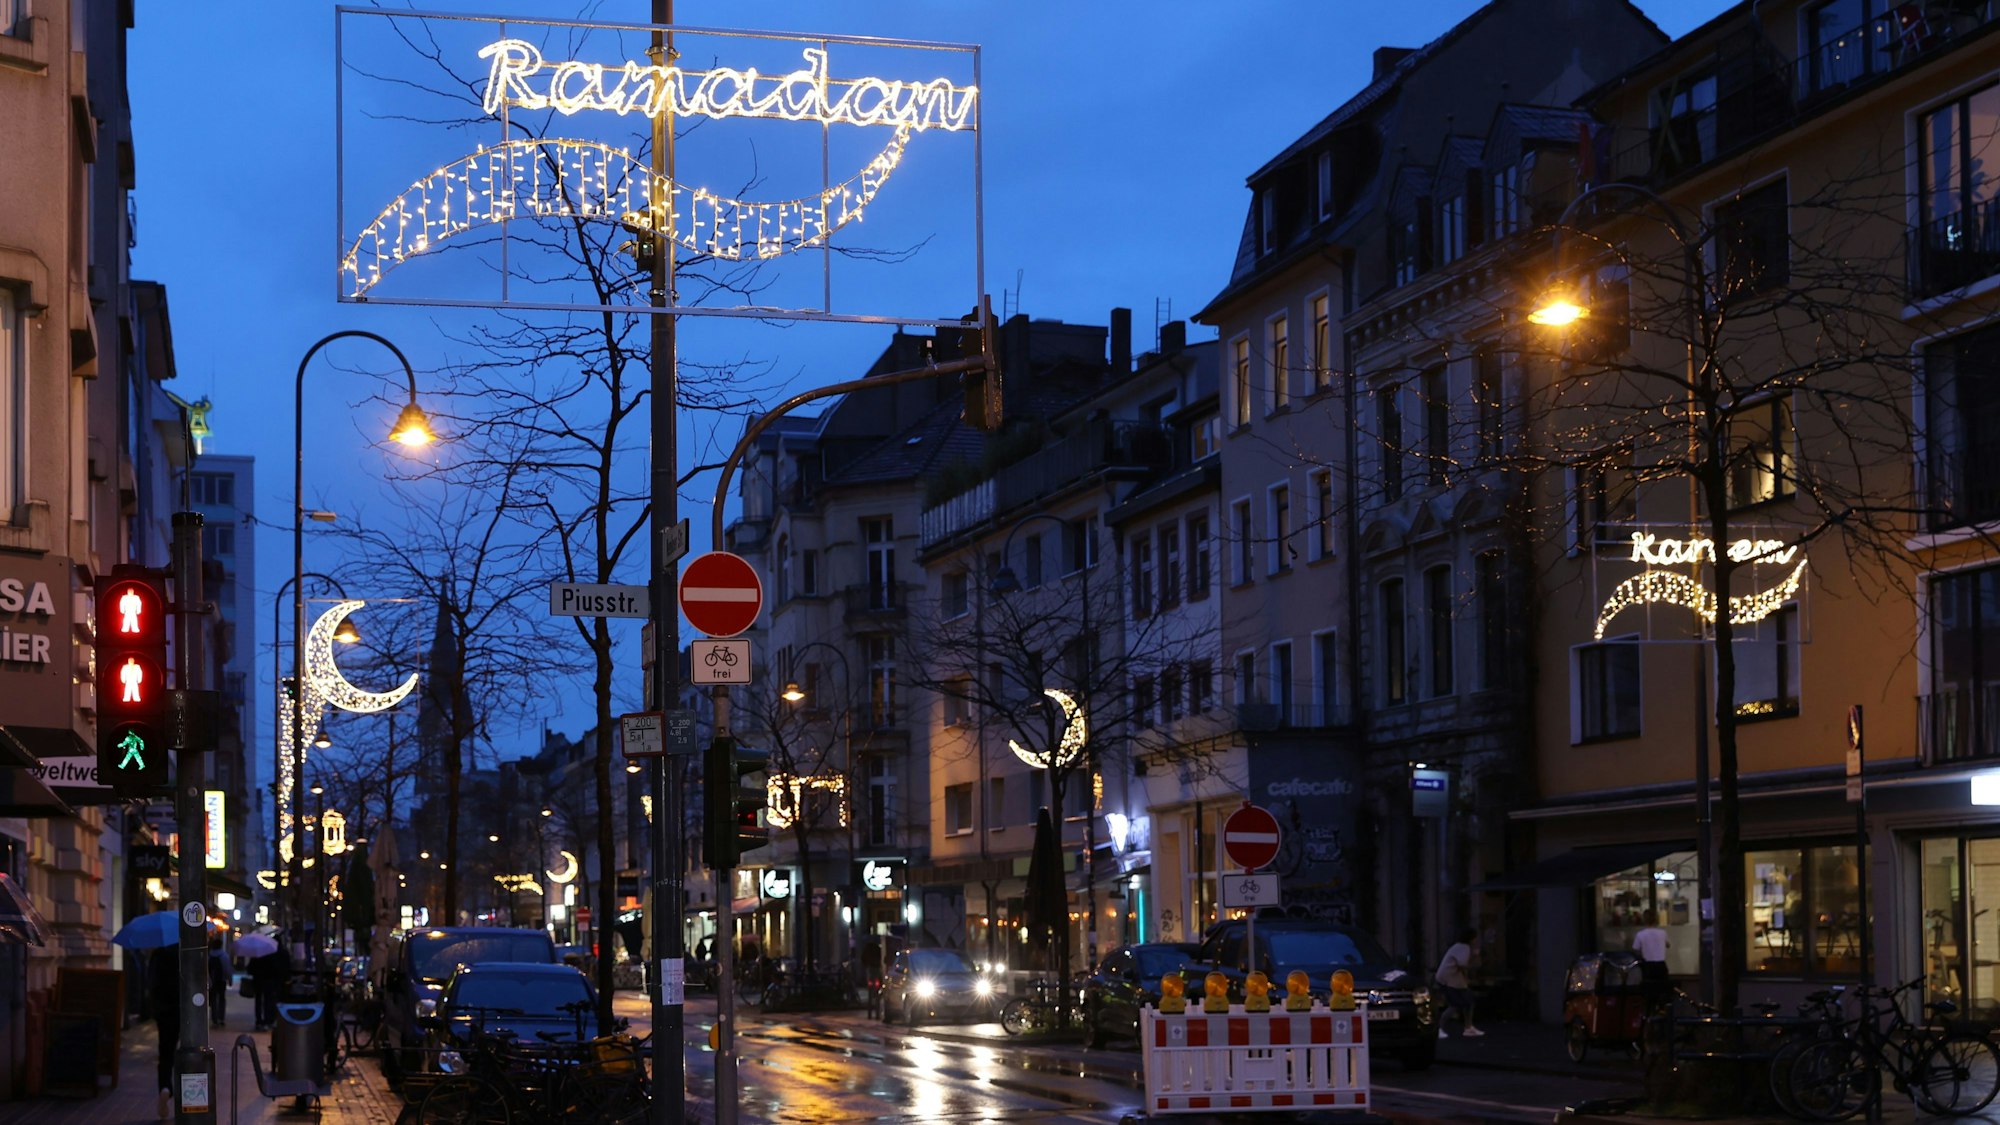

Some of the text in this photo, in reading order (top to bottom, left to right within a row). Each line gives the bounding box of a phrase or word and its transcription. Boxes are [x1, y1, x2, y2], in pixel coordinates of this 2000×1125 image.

[478, 39, 978, 132] Ramadan
[0, 578, 56, 616] SA
[562, 588, 638, 614] Piusstr.
[713, 668, 731, 679] frei
[624, 717, 651, 728] H 200
[207, 797, 218, 861] ZEEMAN
[136, 852, 164, 870] sky
